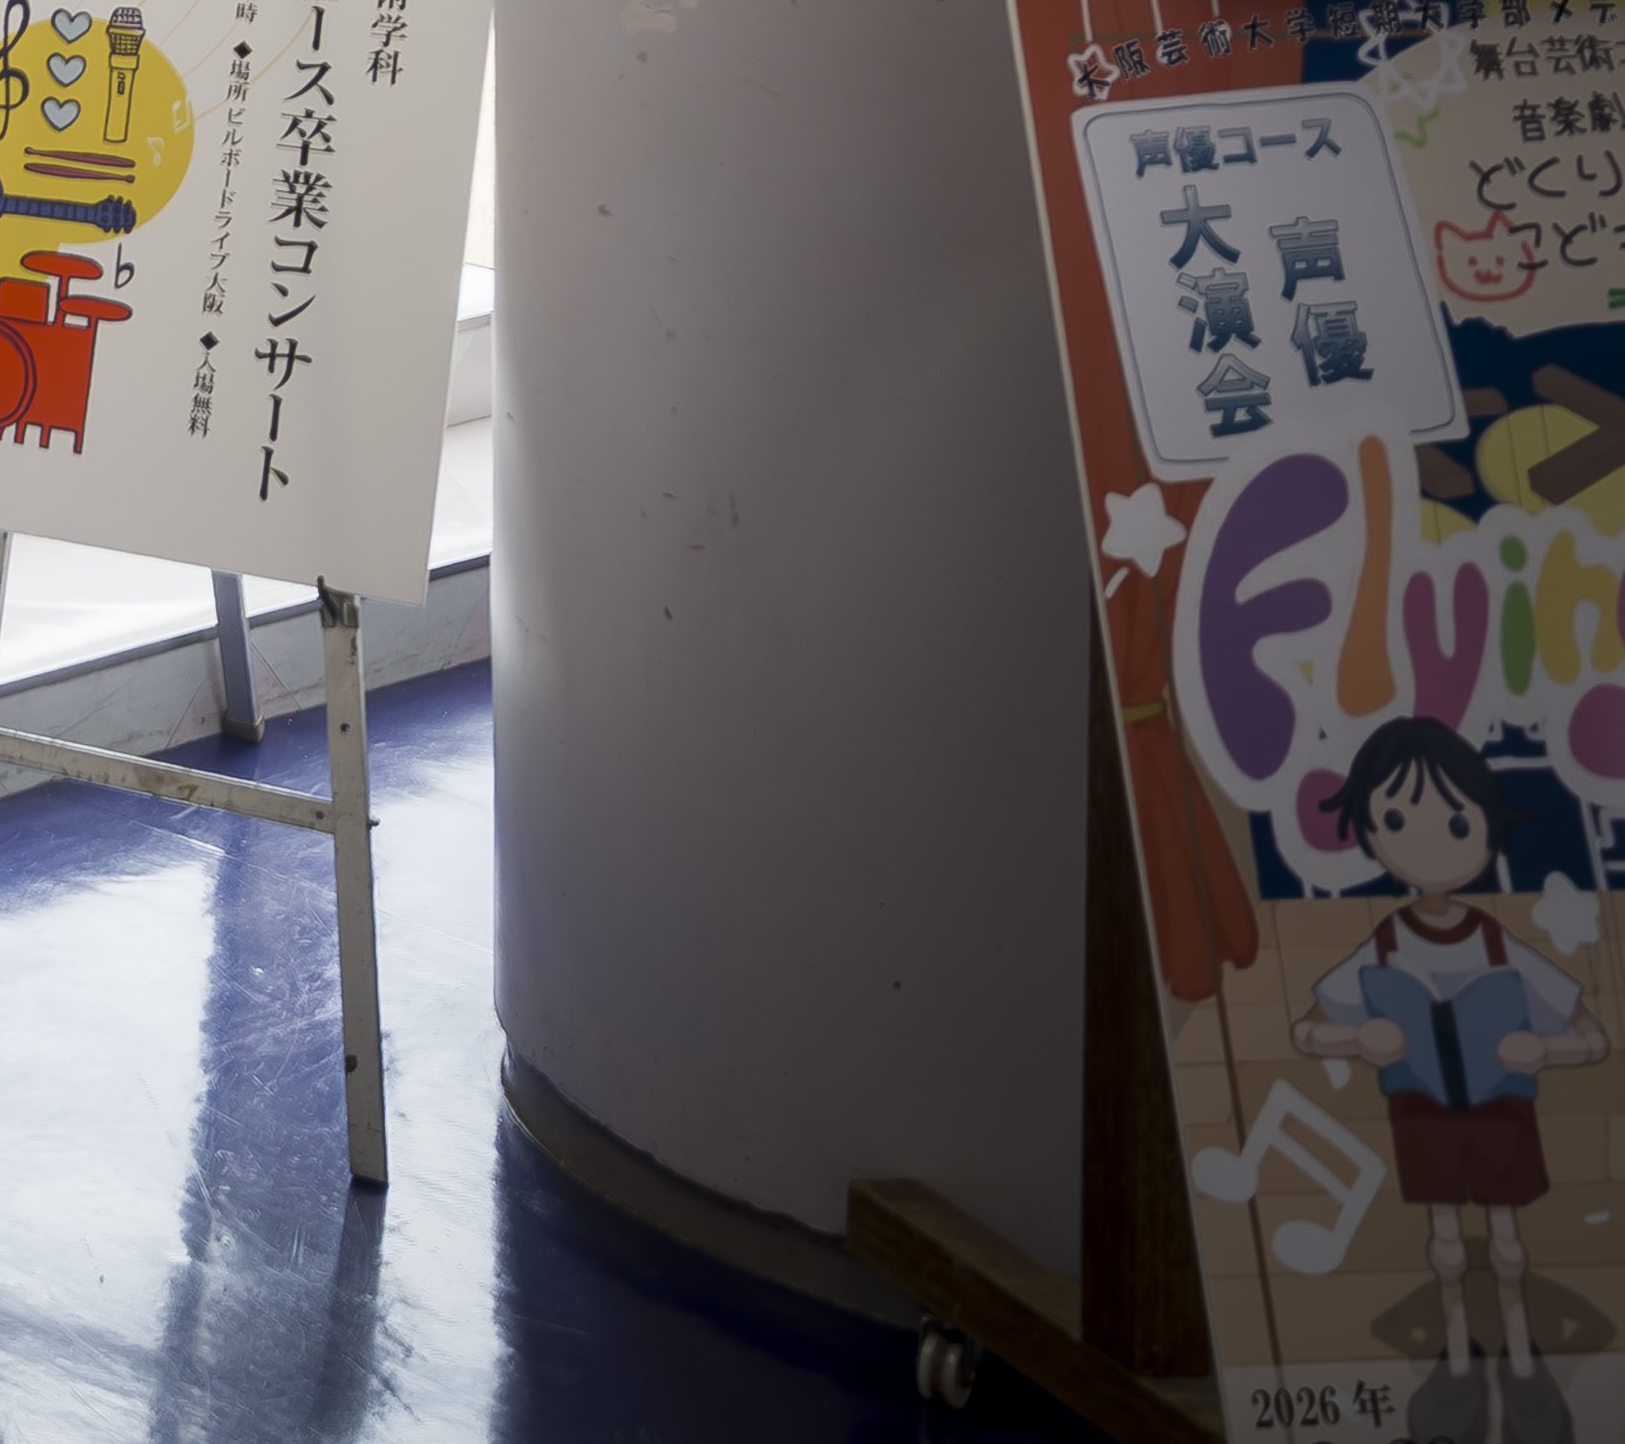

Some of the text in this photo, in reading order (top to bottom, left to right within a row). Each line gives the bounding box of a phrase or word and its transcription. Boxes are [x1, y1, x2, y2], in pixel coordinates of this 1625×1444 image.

[1471, 35, 1625, 80] 舞台芸術
[201, 106, 244, 316] ビルボードライブ大阪
[1129, 115, 1343, 178] 声優コース
[1268, 214, 1374, 388] 声優
[1509, 212, 1625, 273] こど
[1159, 184, 1274, 439] 大演会
[186, 350, 218, 439] 入場無料
[1198, 436, 1625, 783] Flyin
